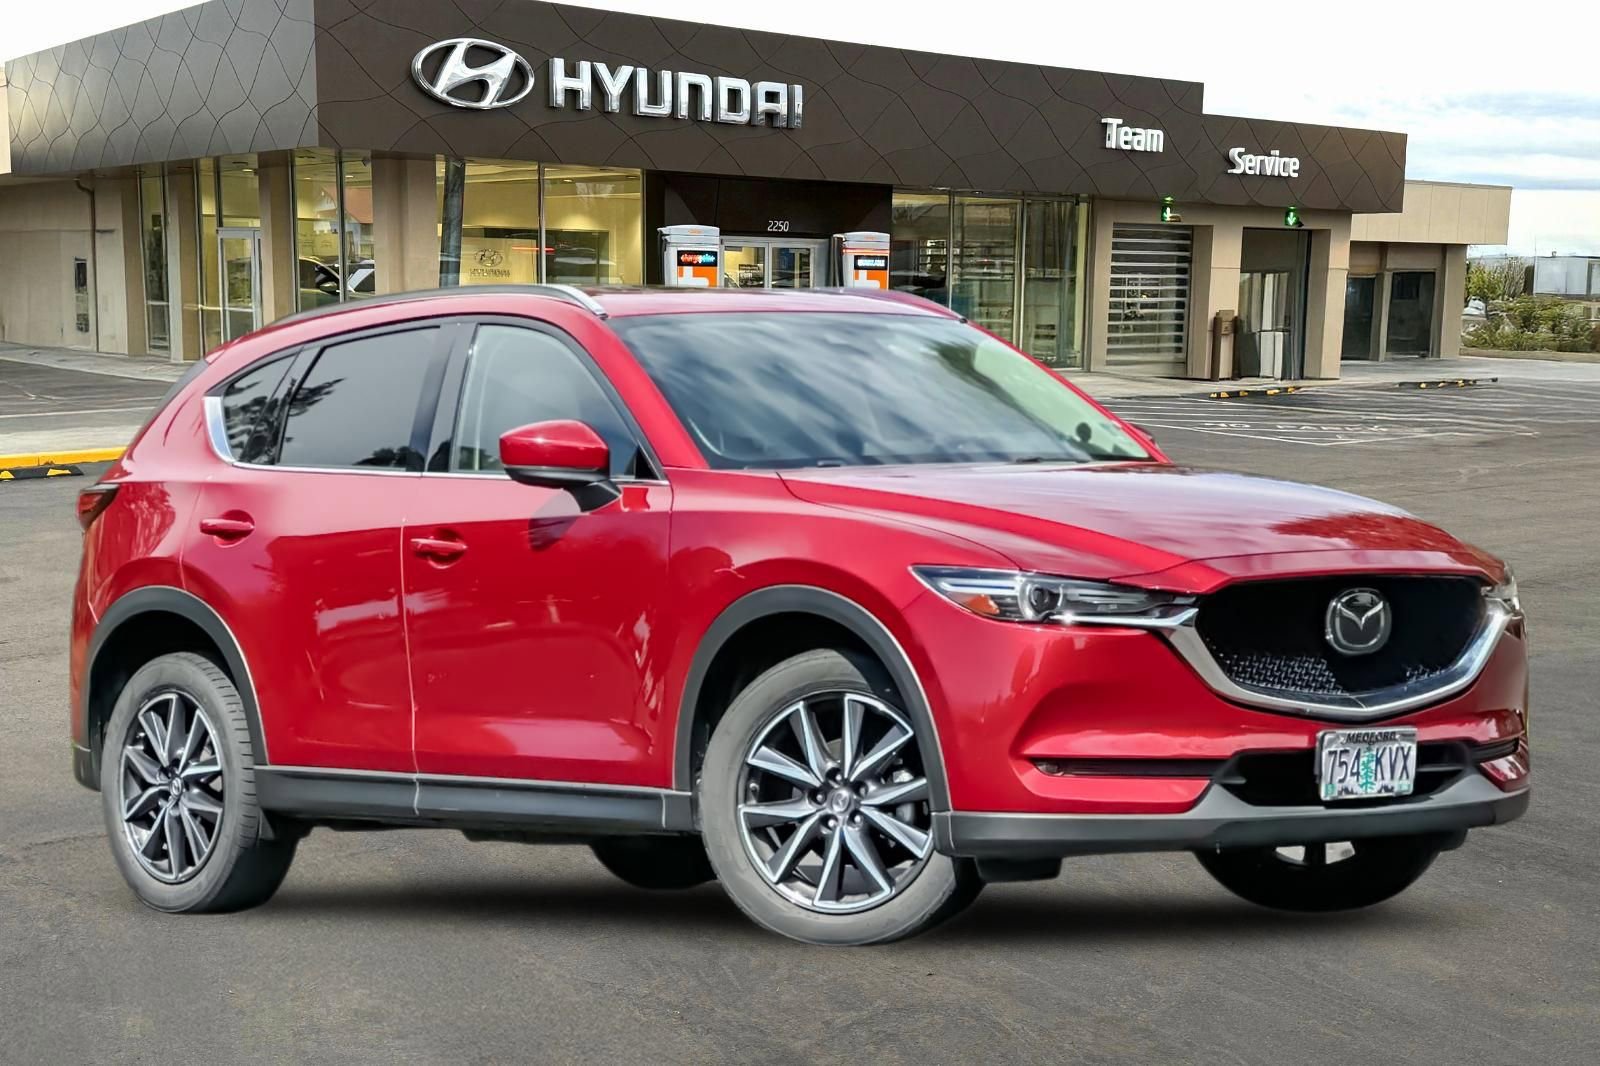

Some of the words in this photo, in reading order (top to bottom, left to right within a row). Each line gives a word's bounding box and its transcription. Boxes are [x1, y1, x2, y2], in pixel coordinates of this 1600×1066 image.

[549, 57, 803, 129] HYUNDAI
[1101, 118, 1163, 152] Team
[1228, 147, 1300, 177] Service
[767, 220, 790, 232] 2250
[1328, 748, 1361, 784] 754
[1375, 746, 1412, 781] KVX
